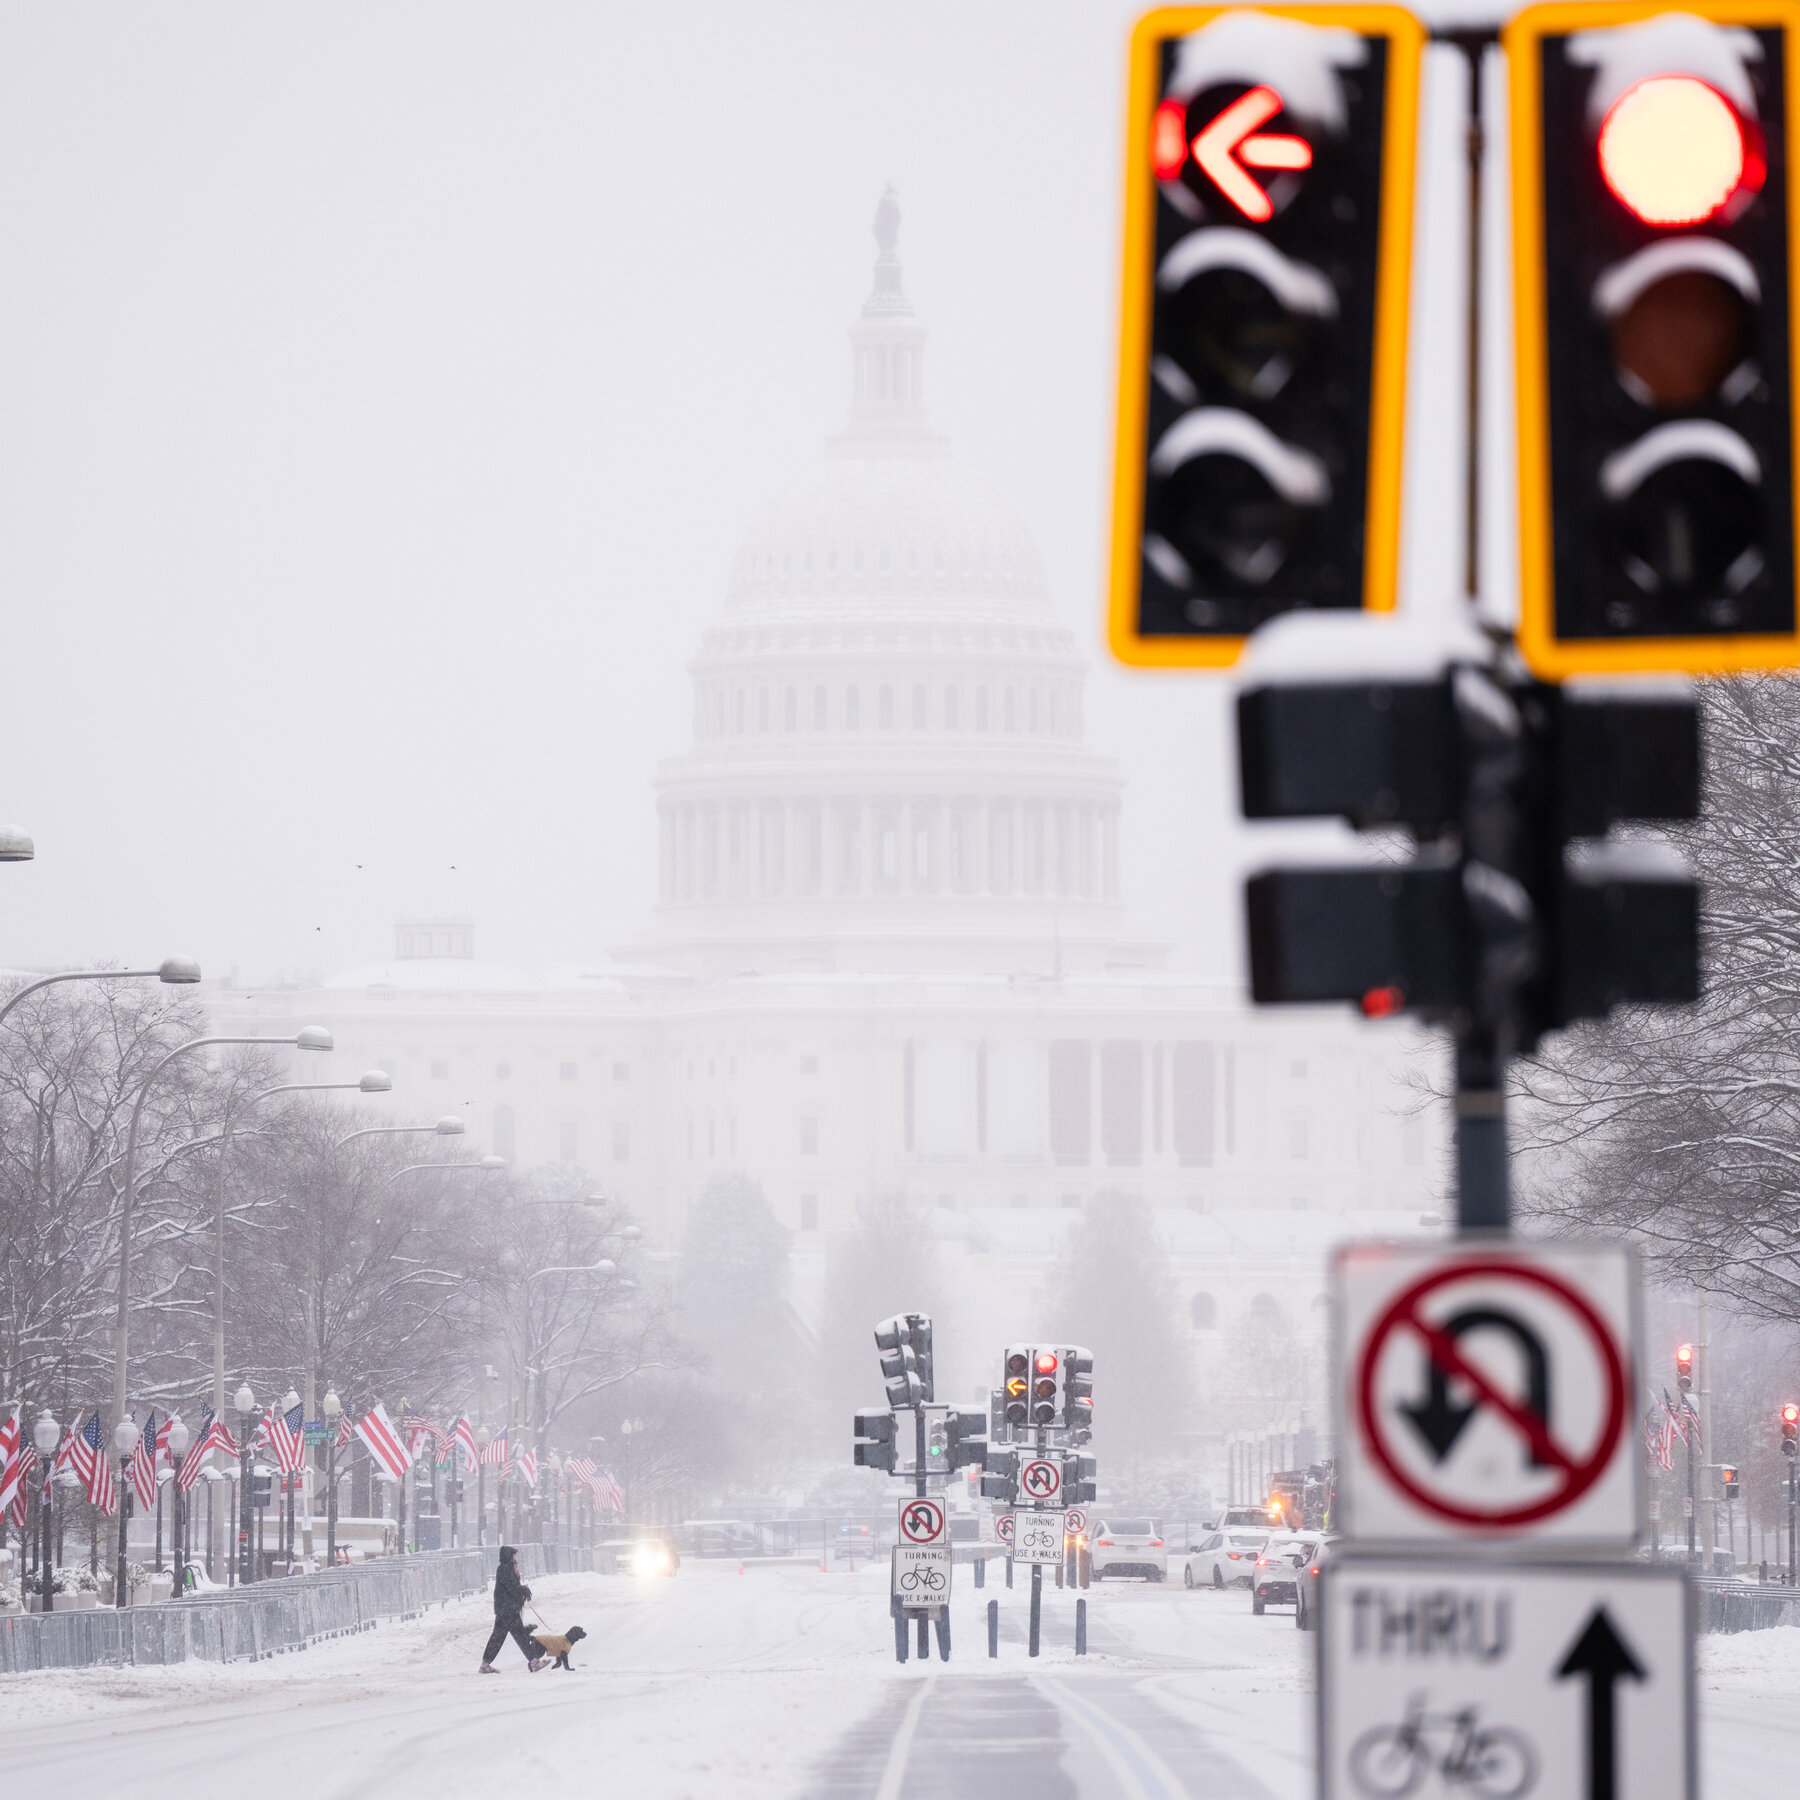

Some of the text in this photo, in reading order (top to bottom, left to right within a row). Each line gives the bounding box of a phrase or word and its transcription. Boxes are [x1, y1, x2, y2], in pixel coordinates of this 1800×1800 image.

[1025, 1517, 1055, 1527] TURNING
[904, 1552, 943, 1560] TURNING
[1014, 1548, 1062, 1560] USE X-WALKS
[916, 1594, 946, 1602] X-WALKS
[1350, 1587, 1513, 1664] THRU
